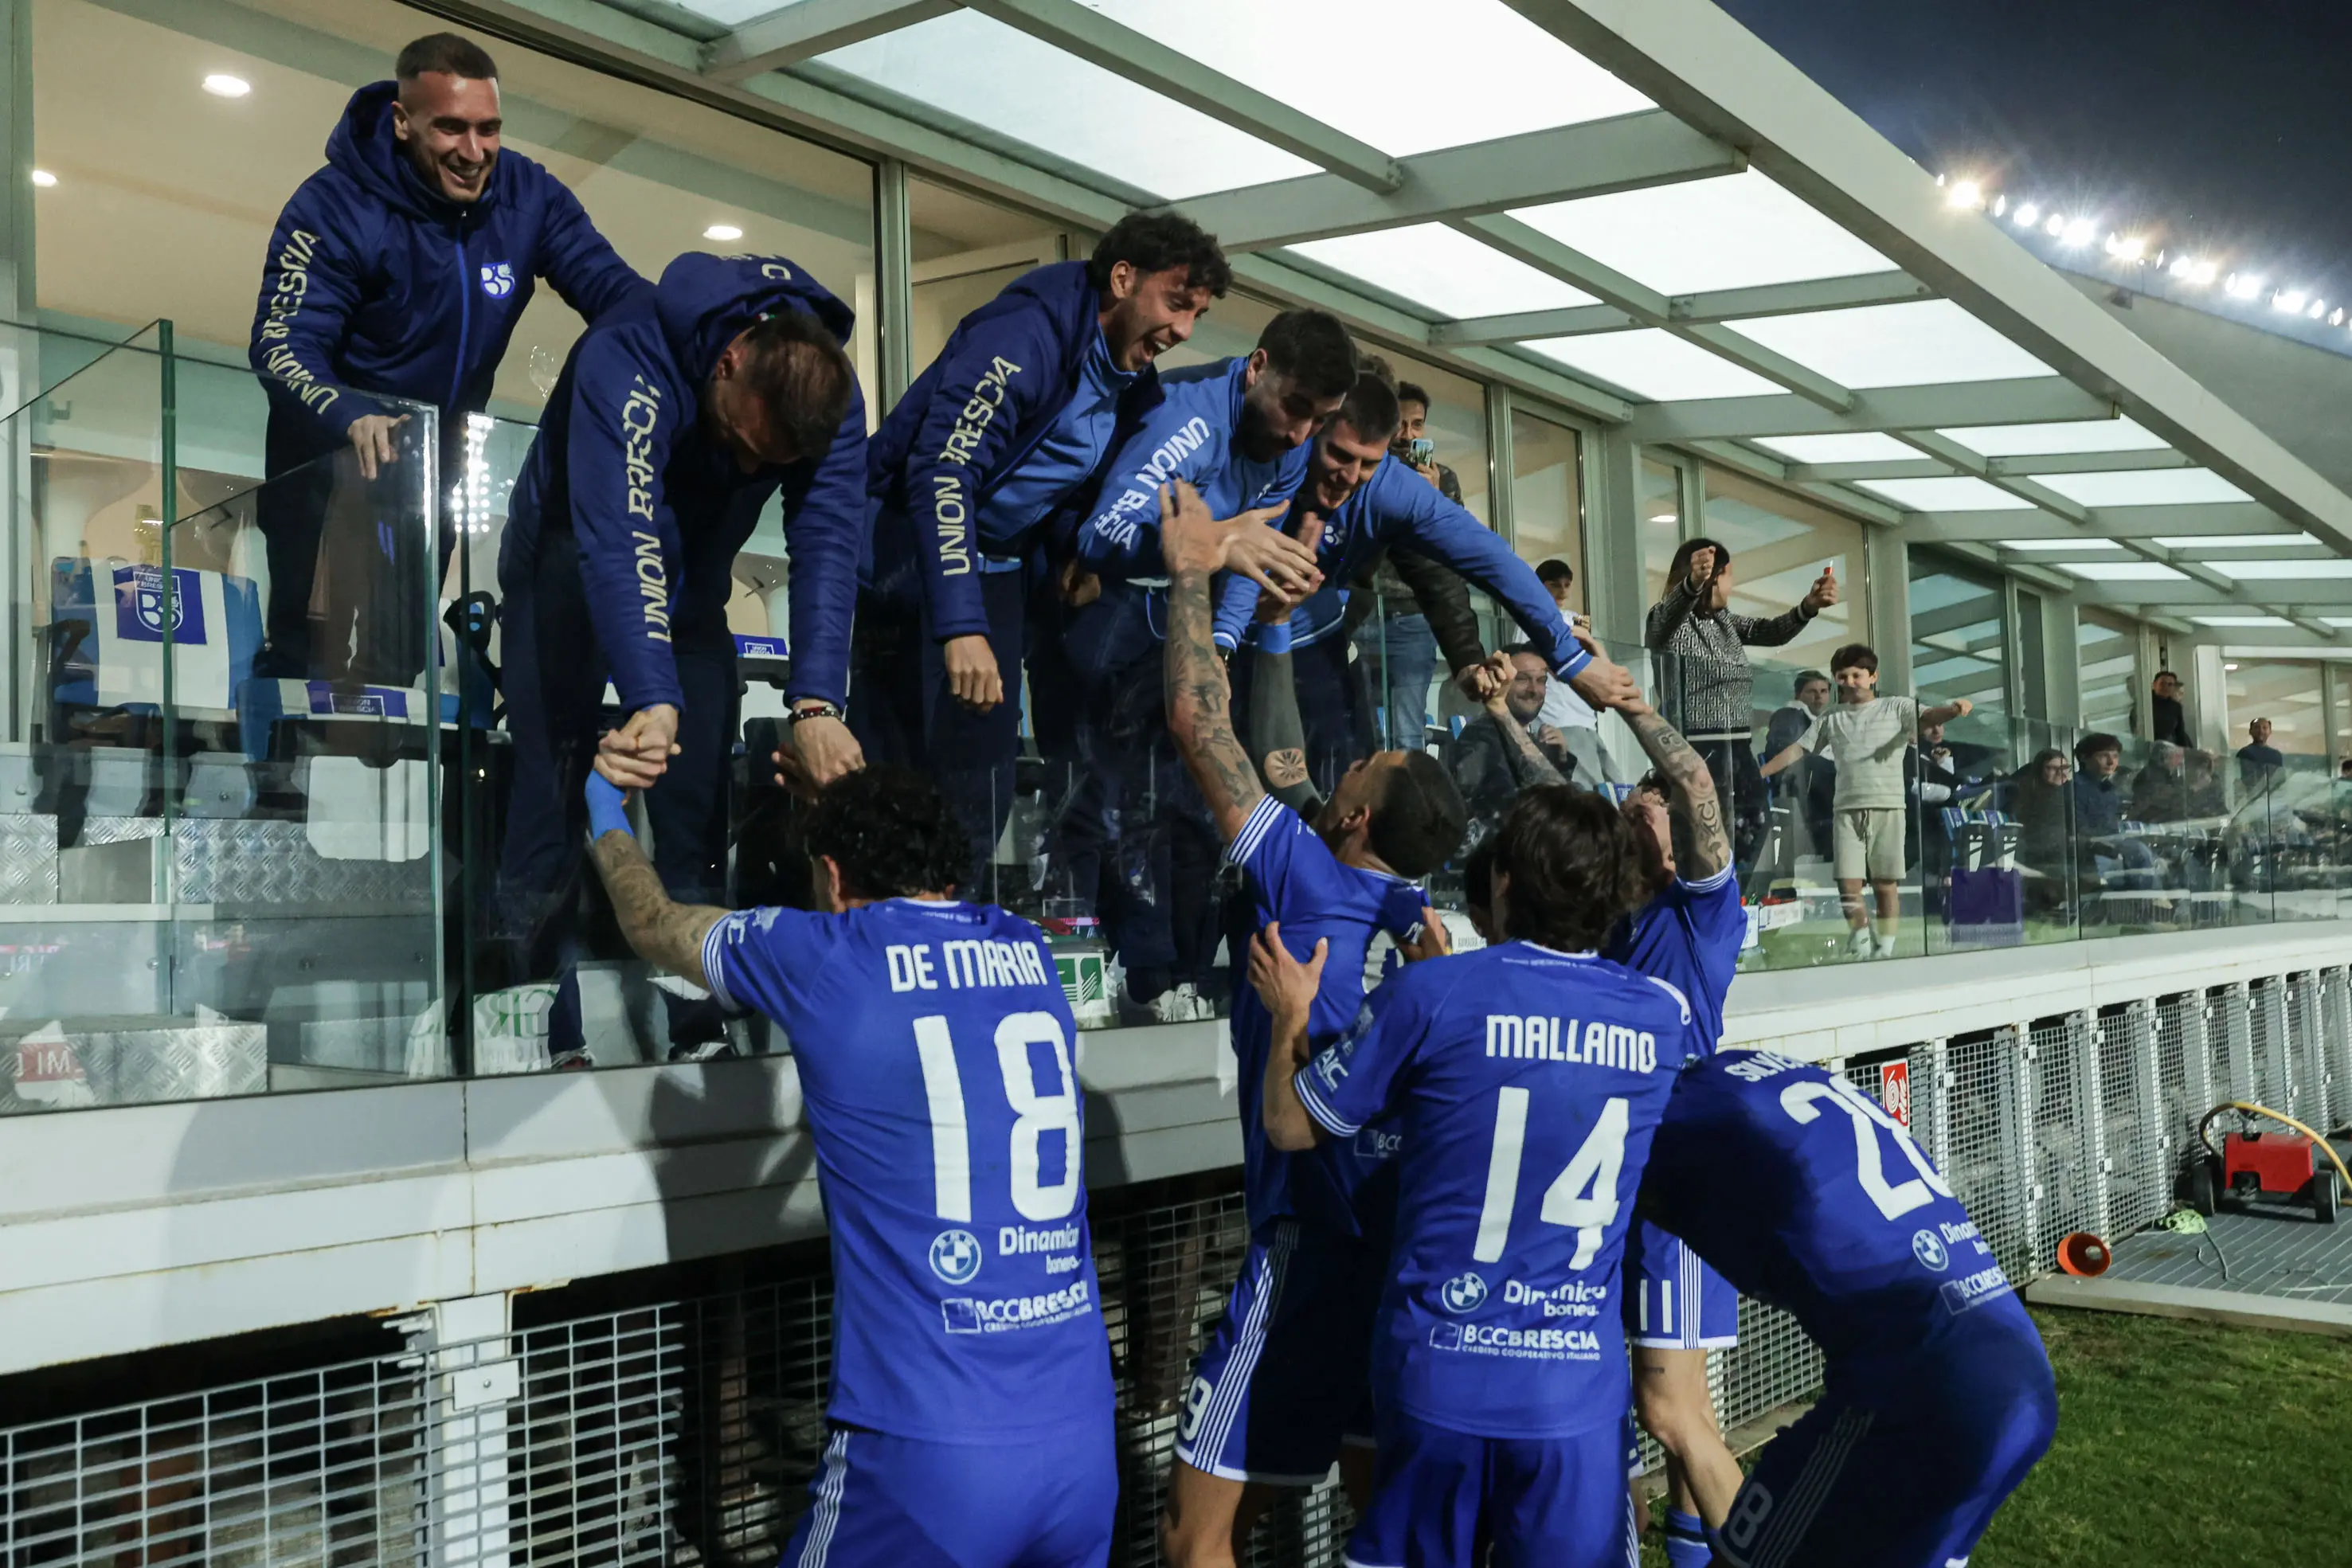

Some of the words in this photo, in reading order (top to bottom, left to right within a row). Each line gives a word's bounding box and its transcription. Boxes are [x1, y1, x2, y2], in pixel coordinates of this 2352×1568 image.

[1135, 416, 1210, 491] UNION
[933, 476, 971, 577] UNION
[886, 944, 938, 992] DE
[942, 940, 1048, 989] MARIA
[1486, 1015, 1657, 1073] MALLAMO
[913, 1011, 1082, 1223] 18
[1473, 1086, 1630, 1271] 14
[1640, 1279, 1673, 1334] 11
[1728, 1481, 1774, 1550] 8
